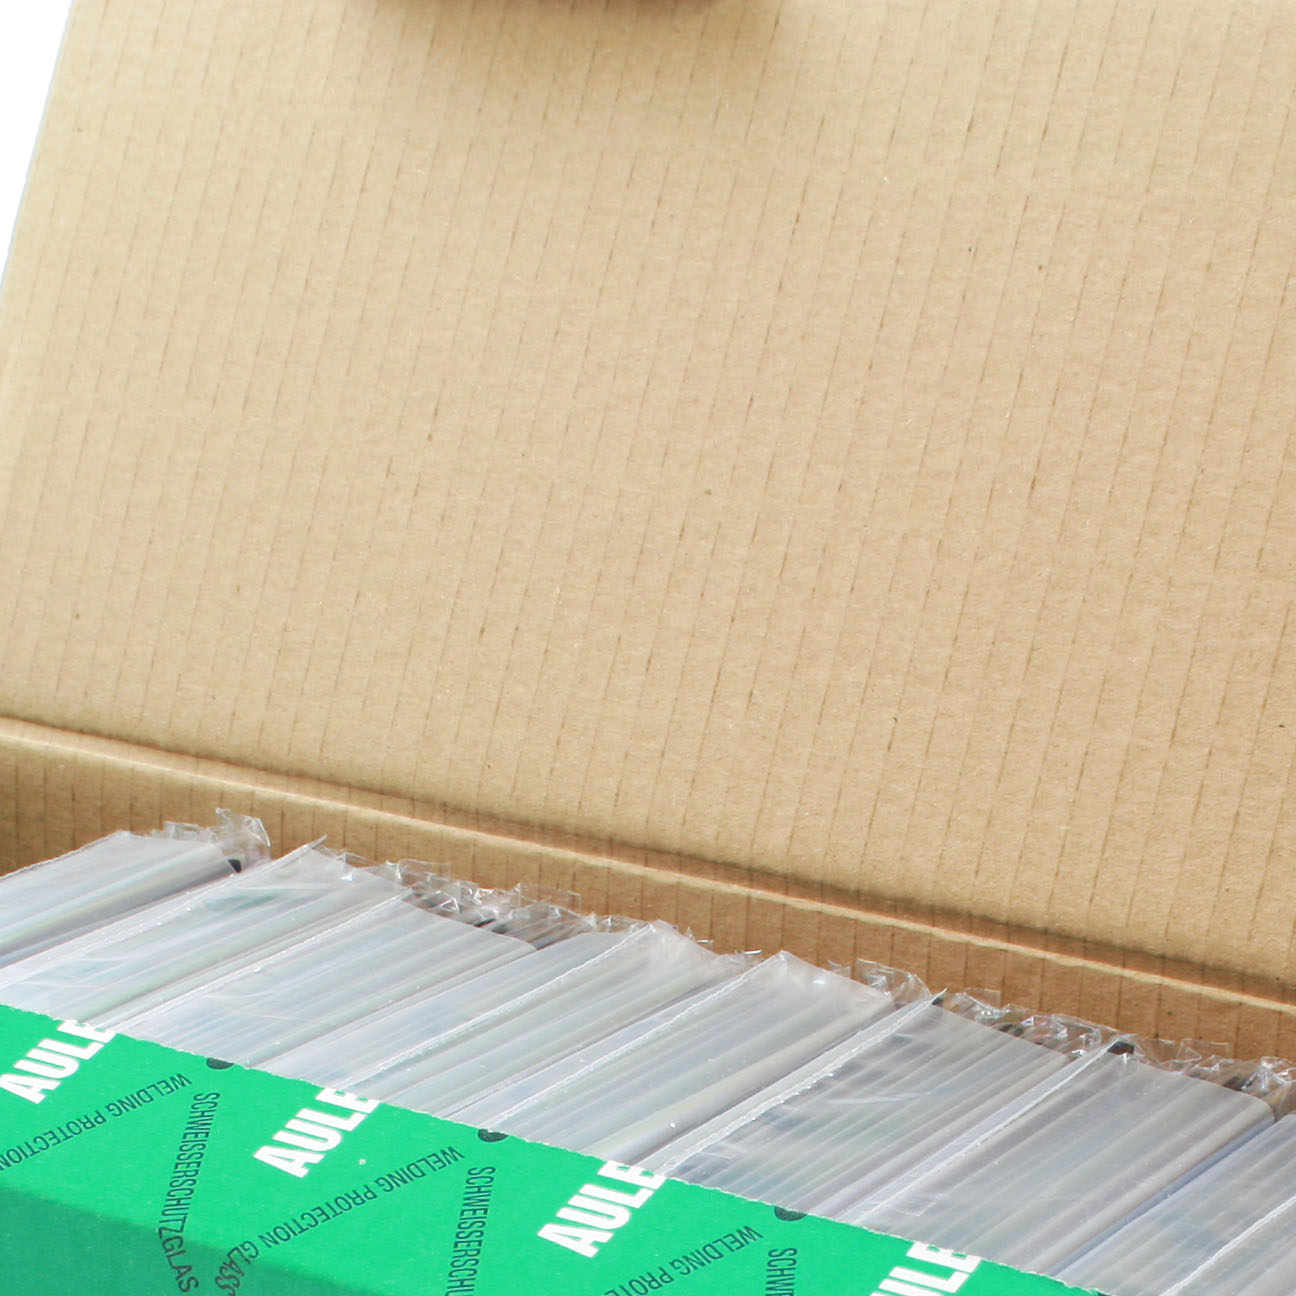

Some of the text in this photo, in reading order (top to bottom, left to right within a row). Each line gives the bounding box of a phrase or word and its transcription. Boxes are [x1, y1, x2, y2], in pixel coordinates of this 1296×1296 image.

[105, 1074, 192, 1117] WELDING
[158, 1092, 220, 1293] SCHWEISSERSCHUTZGLAS
[374, 1147, 464, 1192] WELDING
[258, 1185, 378, 1248] PROTECTION
[669, 1226, 763, 1275] WELDING
